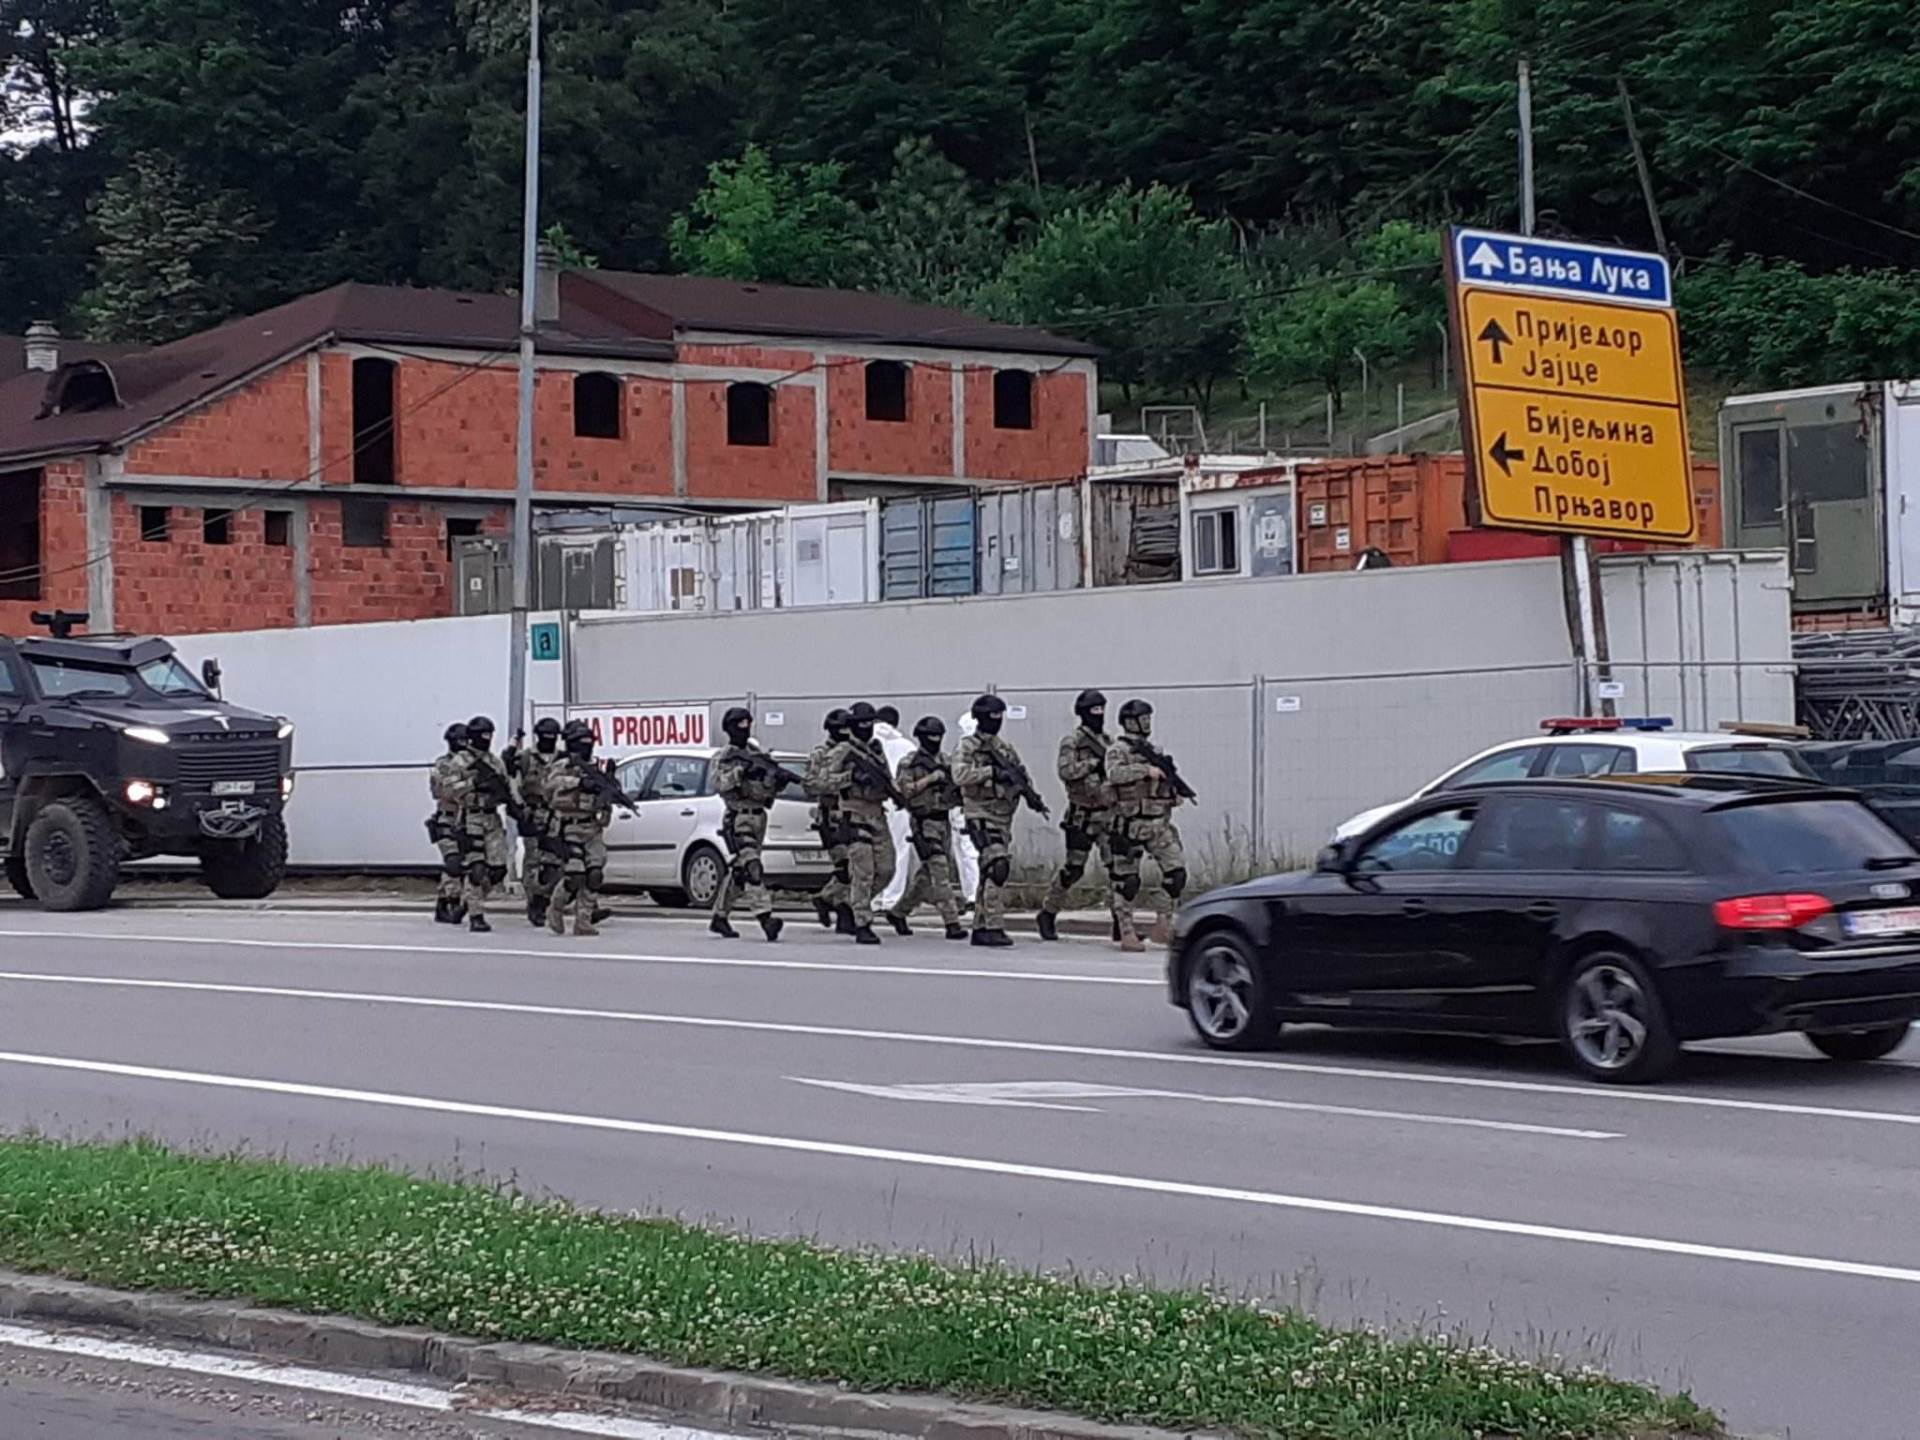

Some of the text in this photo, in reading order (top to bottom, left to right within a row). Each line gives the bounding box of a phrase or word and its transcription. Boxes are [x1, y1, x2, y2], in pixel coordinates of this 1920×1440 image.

[1508, 247, 1651, 293] Бања Лука
[1515, 310, 1643, 357] Приједор
[1522, 351, 1599, 387] Јајце
[1526, 405, 1655, 445] Бијељина
[1532, 446, 1611, 486] Добој
[1535, 486, 1655, 528] Прњавор
[612, 713, 704, 746] PRODAJU
